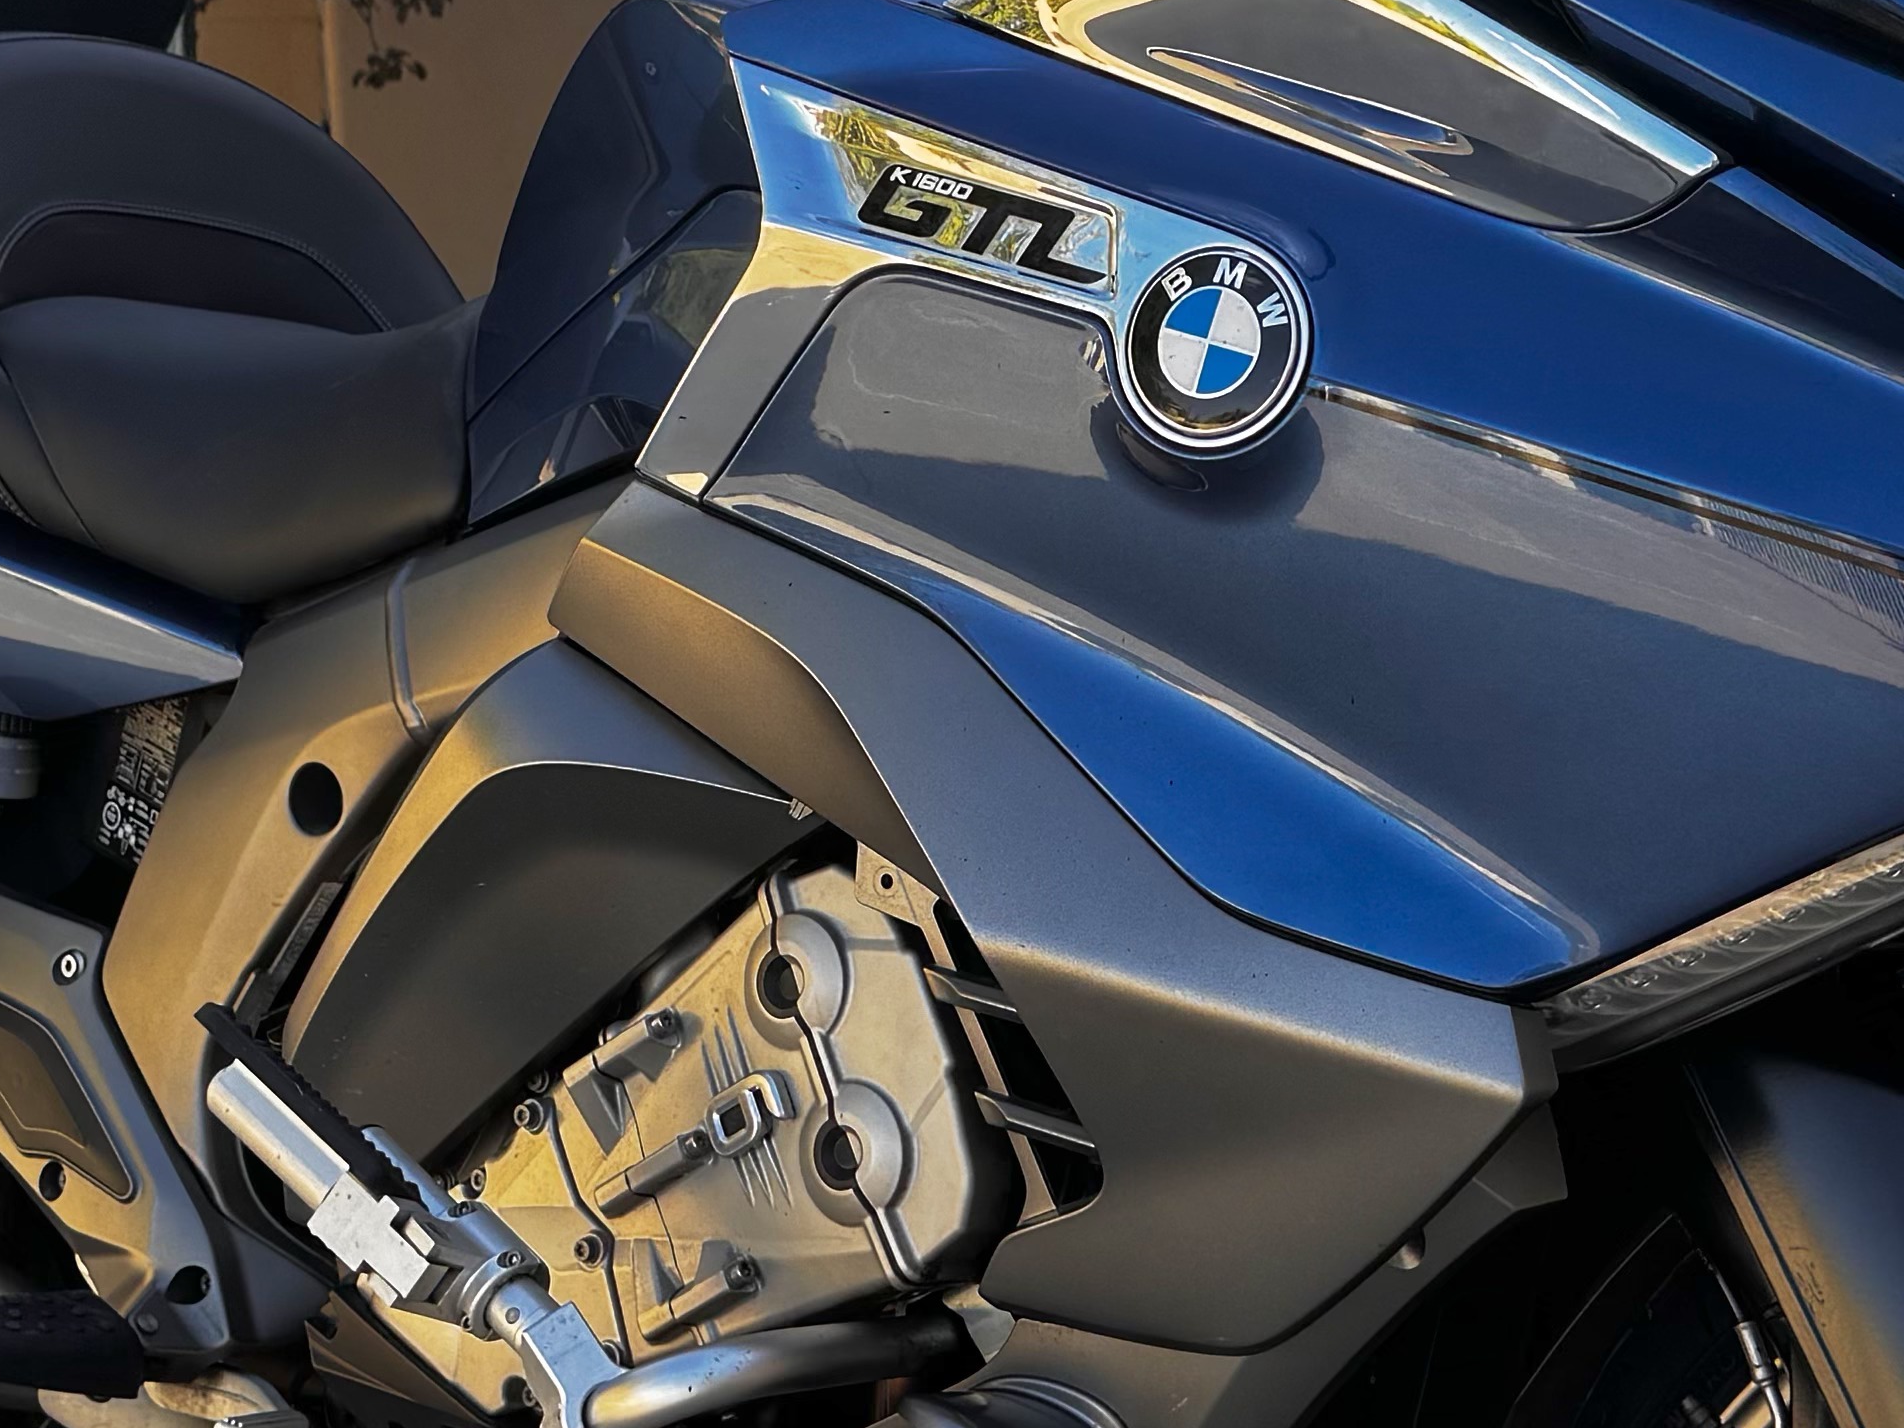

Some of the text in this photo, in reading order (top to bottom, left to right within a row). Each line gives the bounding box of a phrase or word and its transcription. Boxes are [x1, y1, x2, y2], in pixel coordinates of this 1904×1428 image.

[889, 166, 974, 200] K 1600
[856, 164, 1108, 284] GTL
[1161, 257, 1289, 328] BMW
